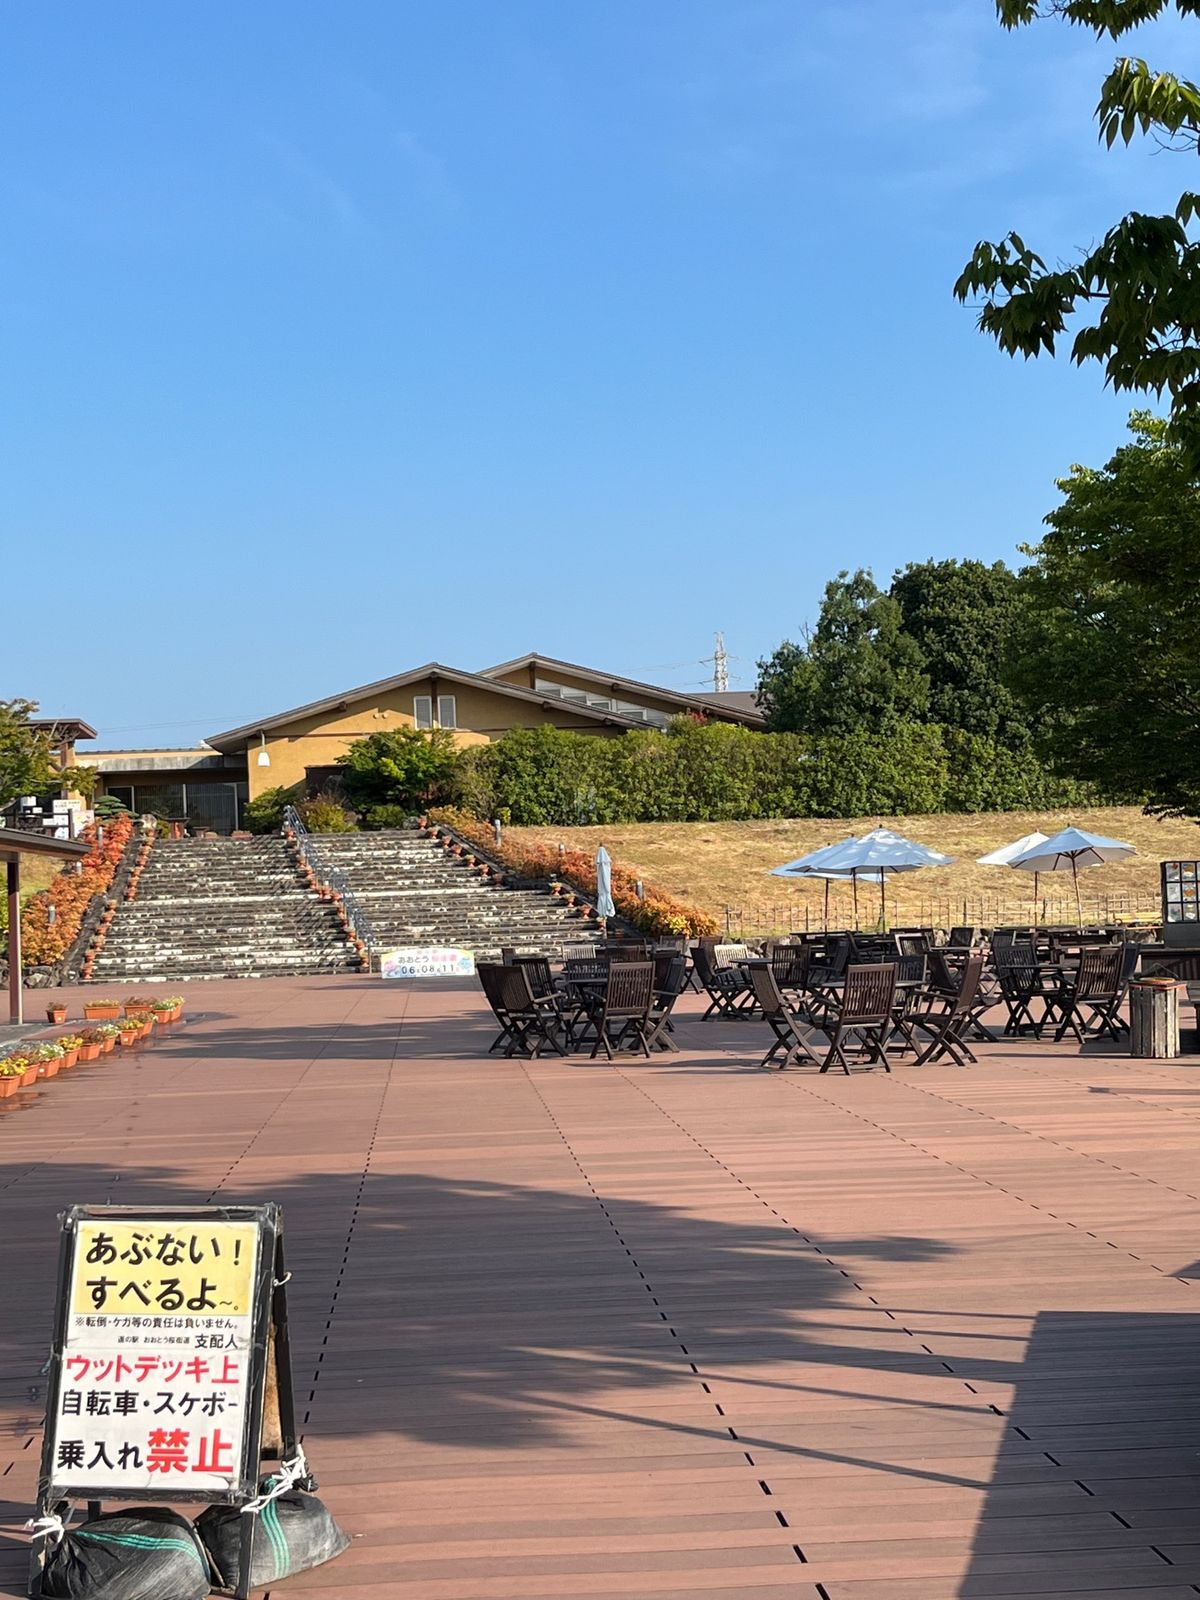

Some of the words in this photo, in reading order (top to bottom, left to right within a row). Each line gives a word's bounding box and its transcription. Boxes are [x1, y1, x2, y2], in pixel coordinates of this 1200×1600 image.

[86, 1231, 242, 1266] あぶない！
[194, 1333, 238, 1349] 支配人
[61, 1388, 239, 1417] 自転車・スケボー
[57, 1427, 234, 1474] 乗入れ禁止
